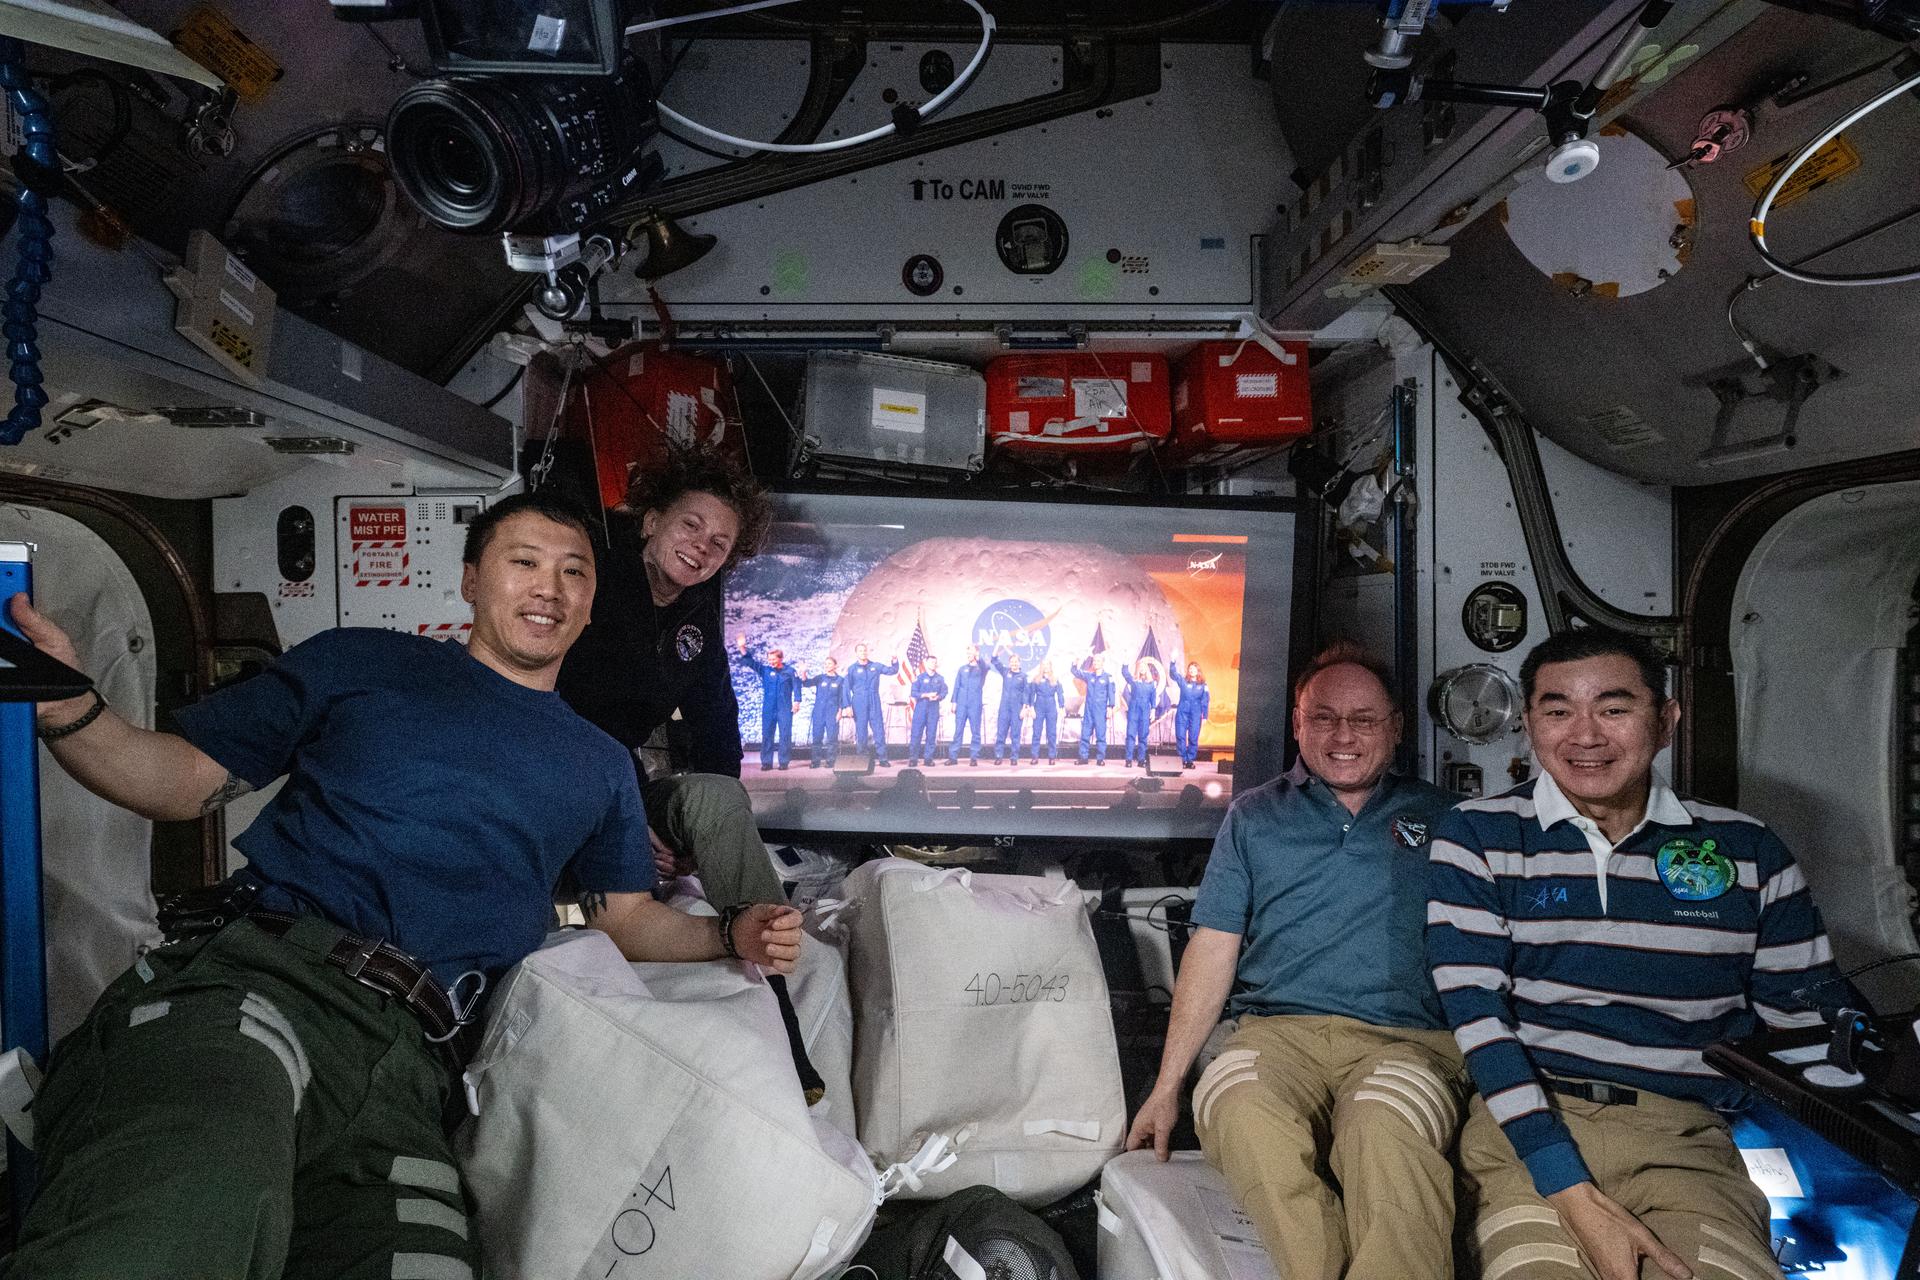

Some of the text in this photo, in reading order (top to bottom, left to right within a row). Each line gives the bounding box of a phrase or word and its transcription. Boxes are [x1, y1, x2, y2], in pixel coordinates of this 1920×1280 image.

[622, 168, 638, 186] Canon
[929, 179, 1004, 200] To CAM
[358, 513, 400, 523] WATER
[353, 525, 405, 535] MIST PFE
[369, 561, 393, 569] FIRE
[1189, 561, 1217, 569] NASA
[978, 628, 1048, 647] NASA
